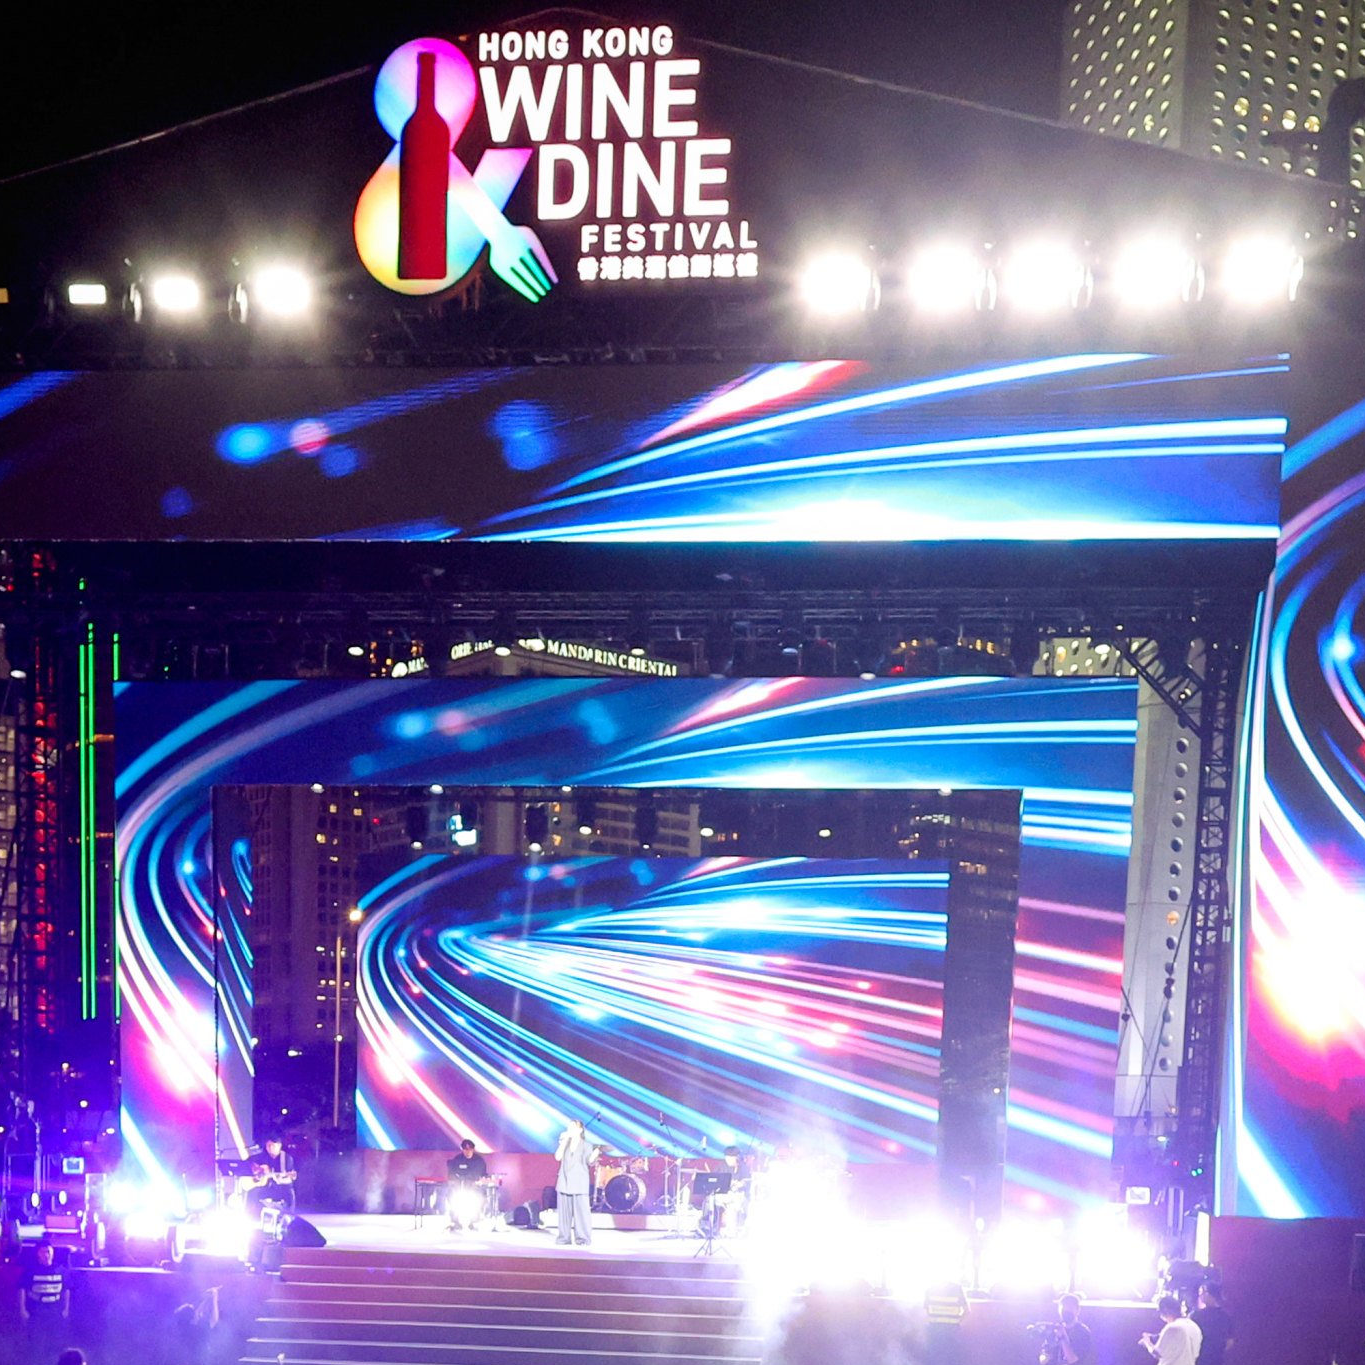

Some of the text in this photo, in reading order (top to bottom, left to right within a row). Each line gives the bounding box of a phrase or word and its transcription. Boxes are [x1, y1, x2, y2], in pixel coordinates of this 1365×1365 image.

[478, 25, 673, 62] HONG KONG
[478, 58, 701, 143] WINE
[537, 138, 732, 221] DINE
[580, 220, 758, 253] FESTIVAL
